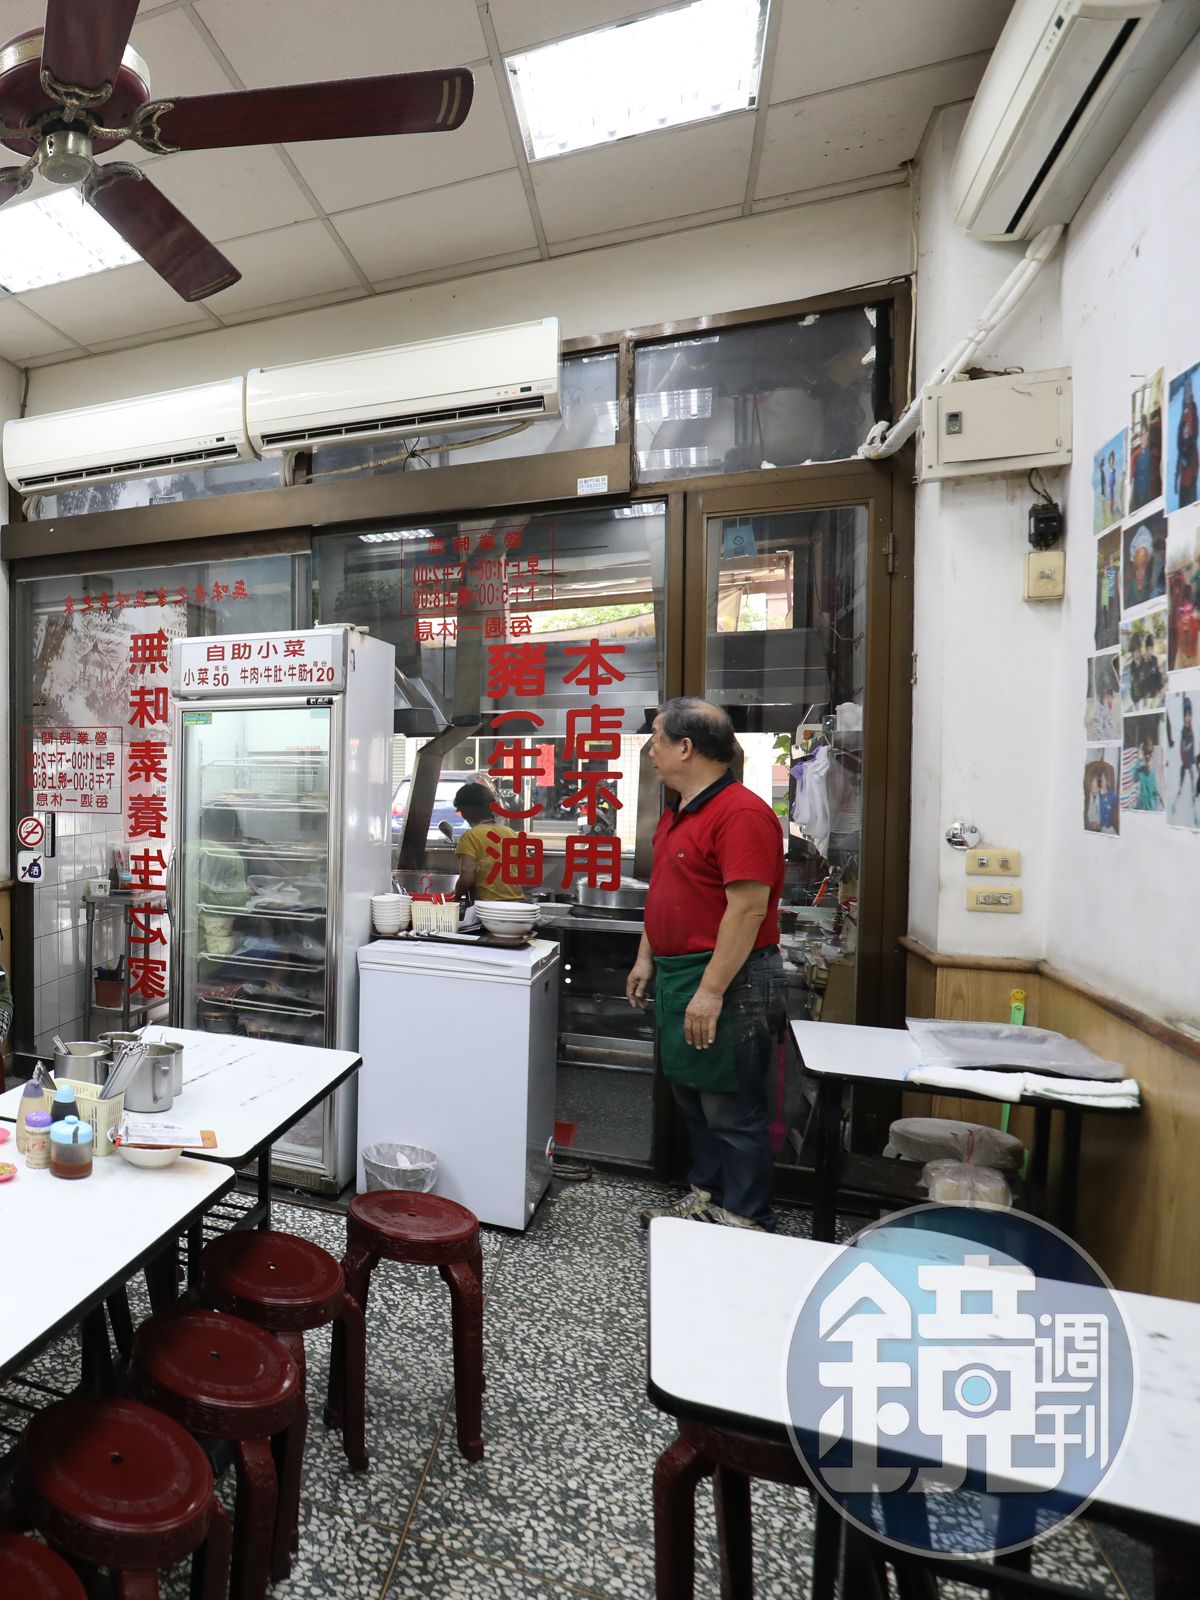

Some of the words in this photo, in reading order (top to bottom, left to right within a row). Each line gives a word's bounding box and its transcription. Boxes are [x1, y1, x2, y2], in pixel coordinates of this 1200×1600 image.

[183, 667, 210, 686] 小菜
[212, 672, 230, 687] 50
[307, 666, 335, 683] 120
[206, 639, 305, 662] 自助小菜
[486, 642, 547, 887] 豬(牛)油
[561, 638, 627, 892] 本店不用
